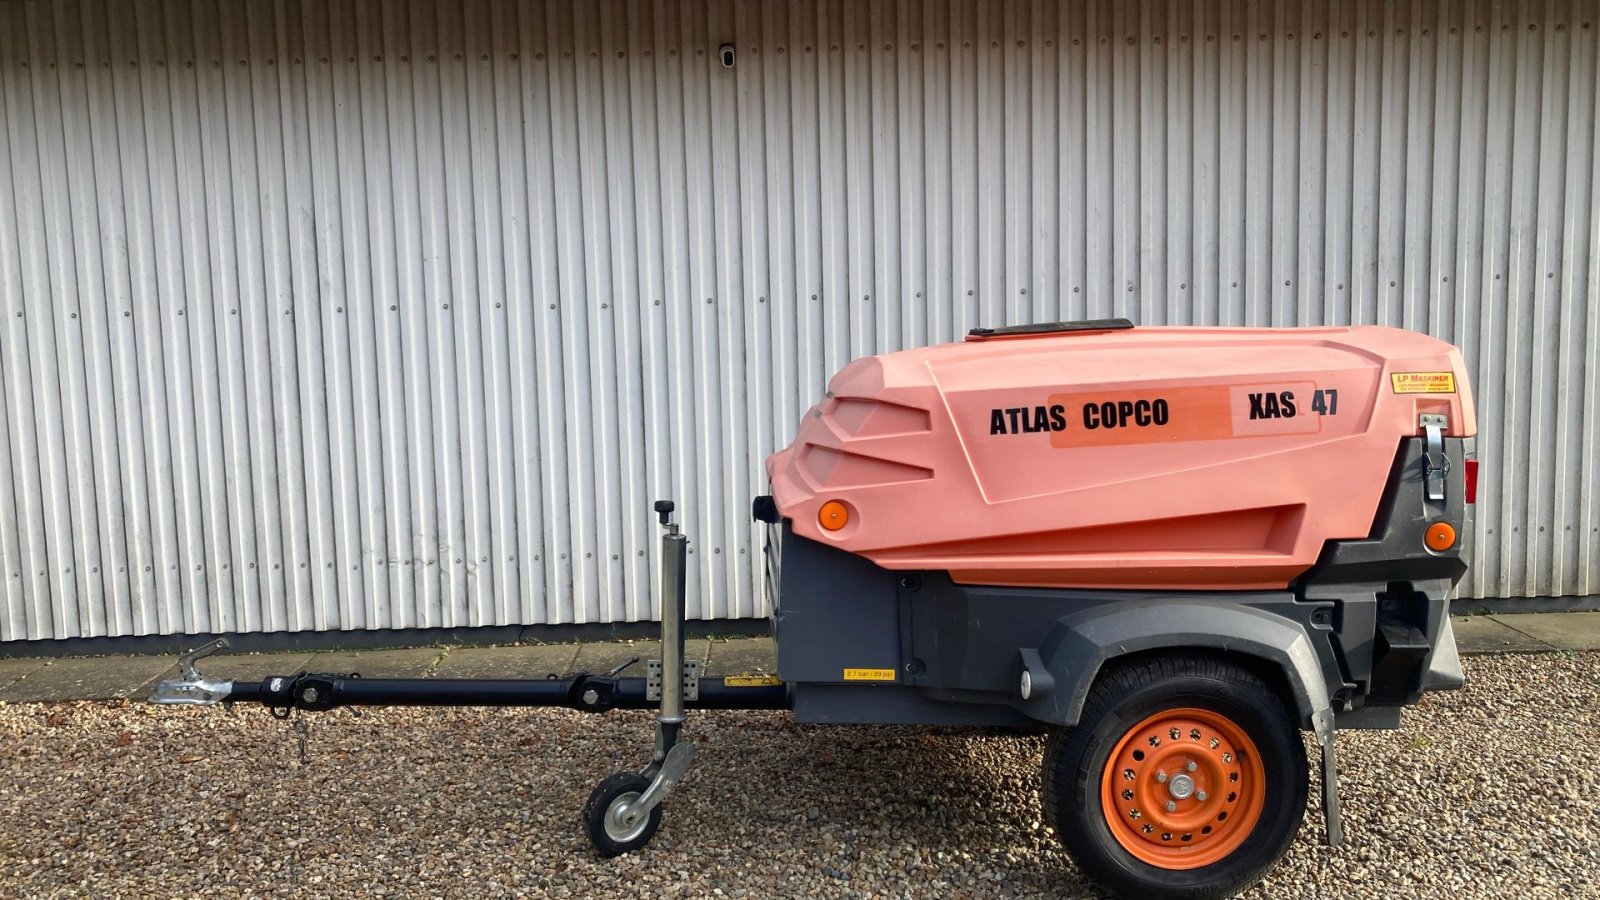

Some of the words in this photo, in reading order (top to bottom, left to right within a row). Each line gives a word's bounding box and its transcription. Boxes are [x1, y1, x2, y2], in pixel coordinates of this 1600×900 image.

[990, 405, 1066, 436] ATLAS
[1083, 398, 1169, 430] COPCO
[1248, 392, 1297, 420] XAS
[1312, 389, 1338, 416] 47
